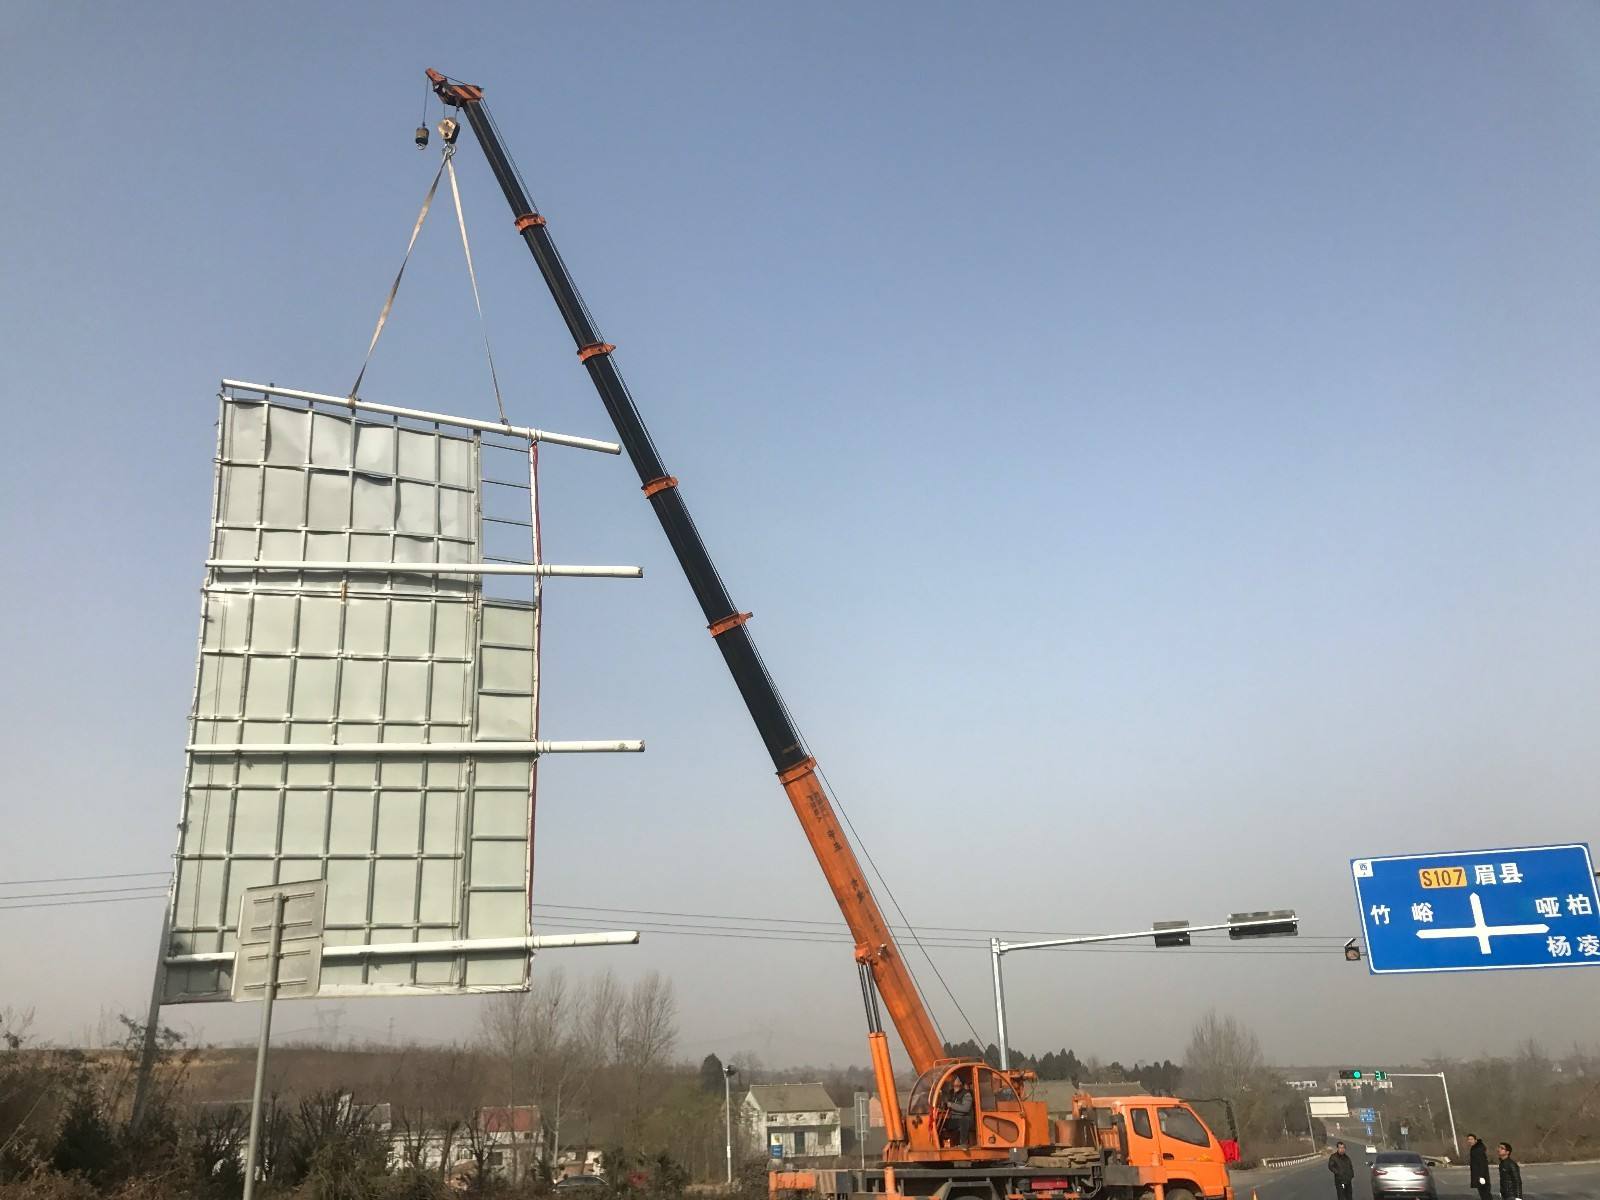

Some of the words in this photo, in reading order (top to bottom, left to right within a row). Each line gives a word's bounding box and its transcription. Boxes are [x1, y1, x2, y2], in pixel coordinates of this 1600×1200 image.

[1422, 869, 1463, 887] S107
[1474, 862, 1524, 885] 眉县
[1370, 902, 1434, 925] 竹峪
[1535, 894, 1593, 918] 哑柏
[1546, 935, 1600, 957] 杨凌
